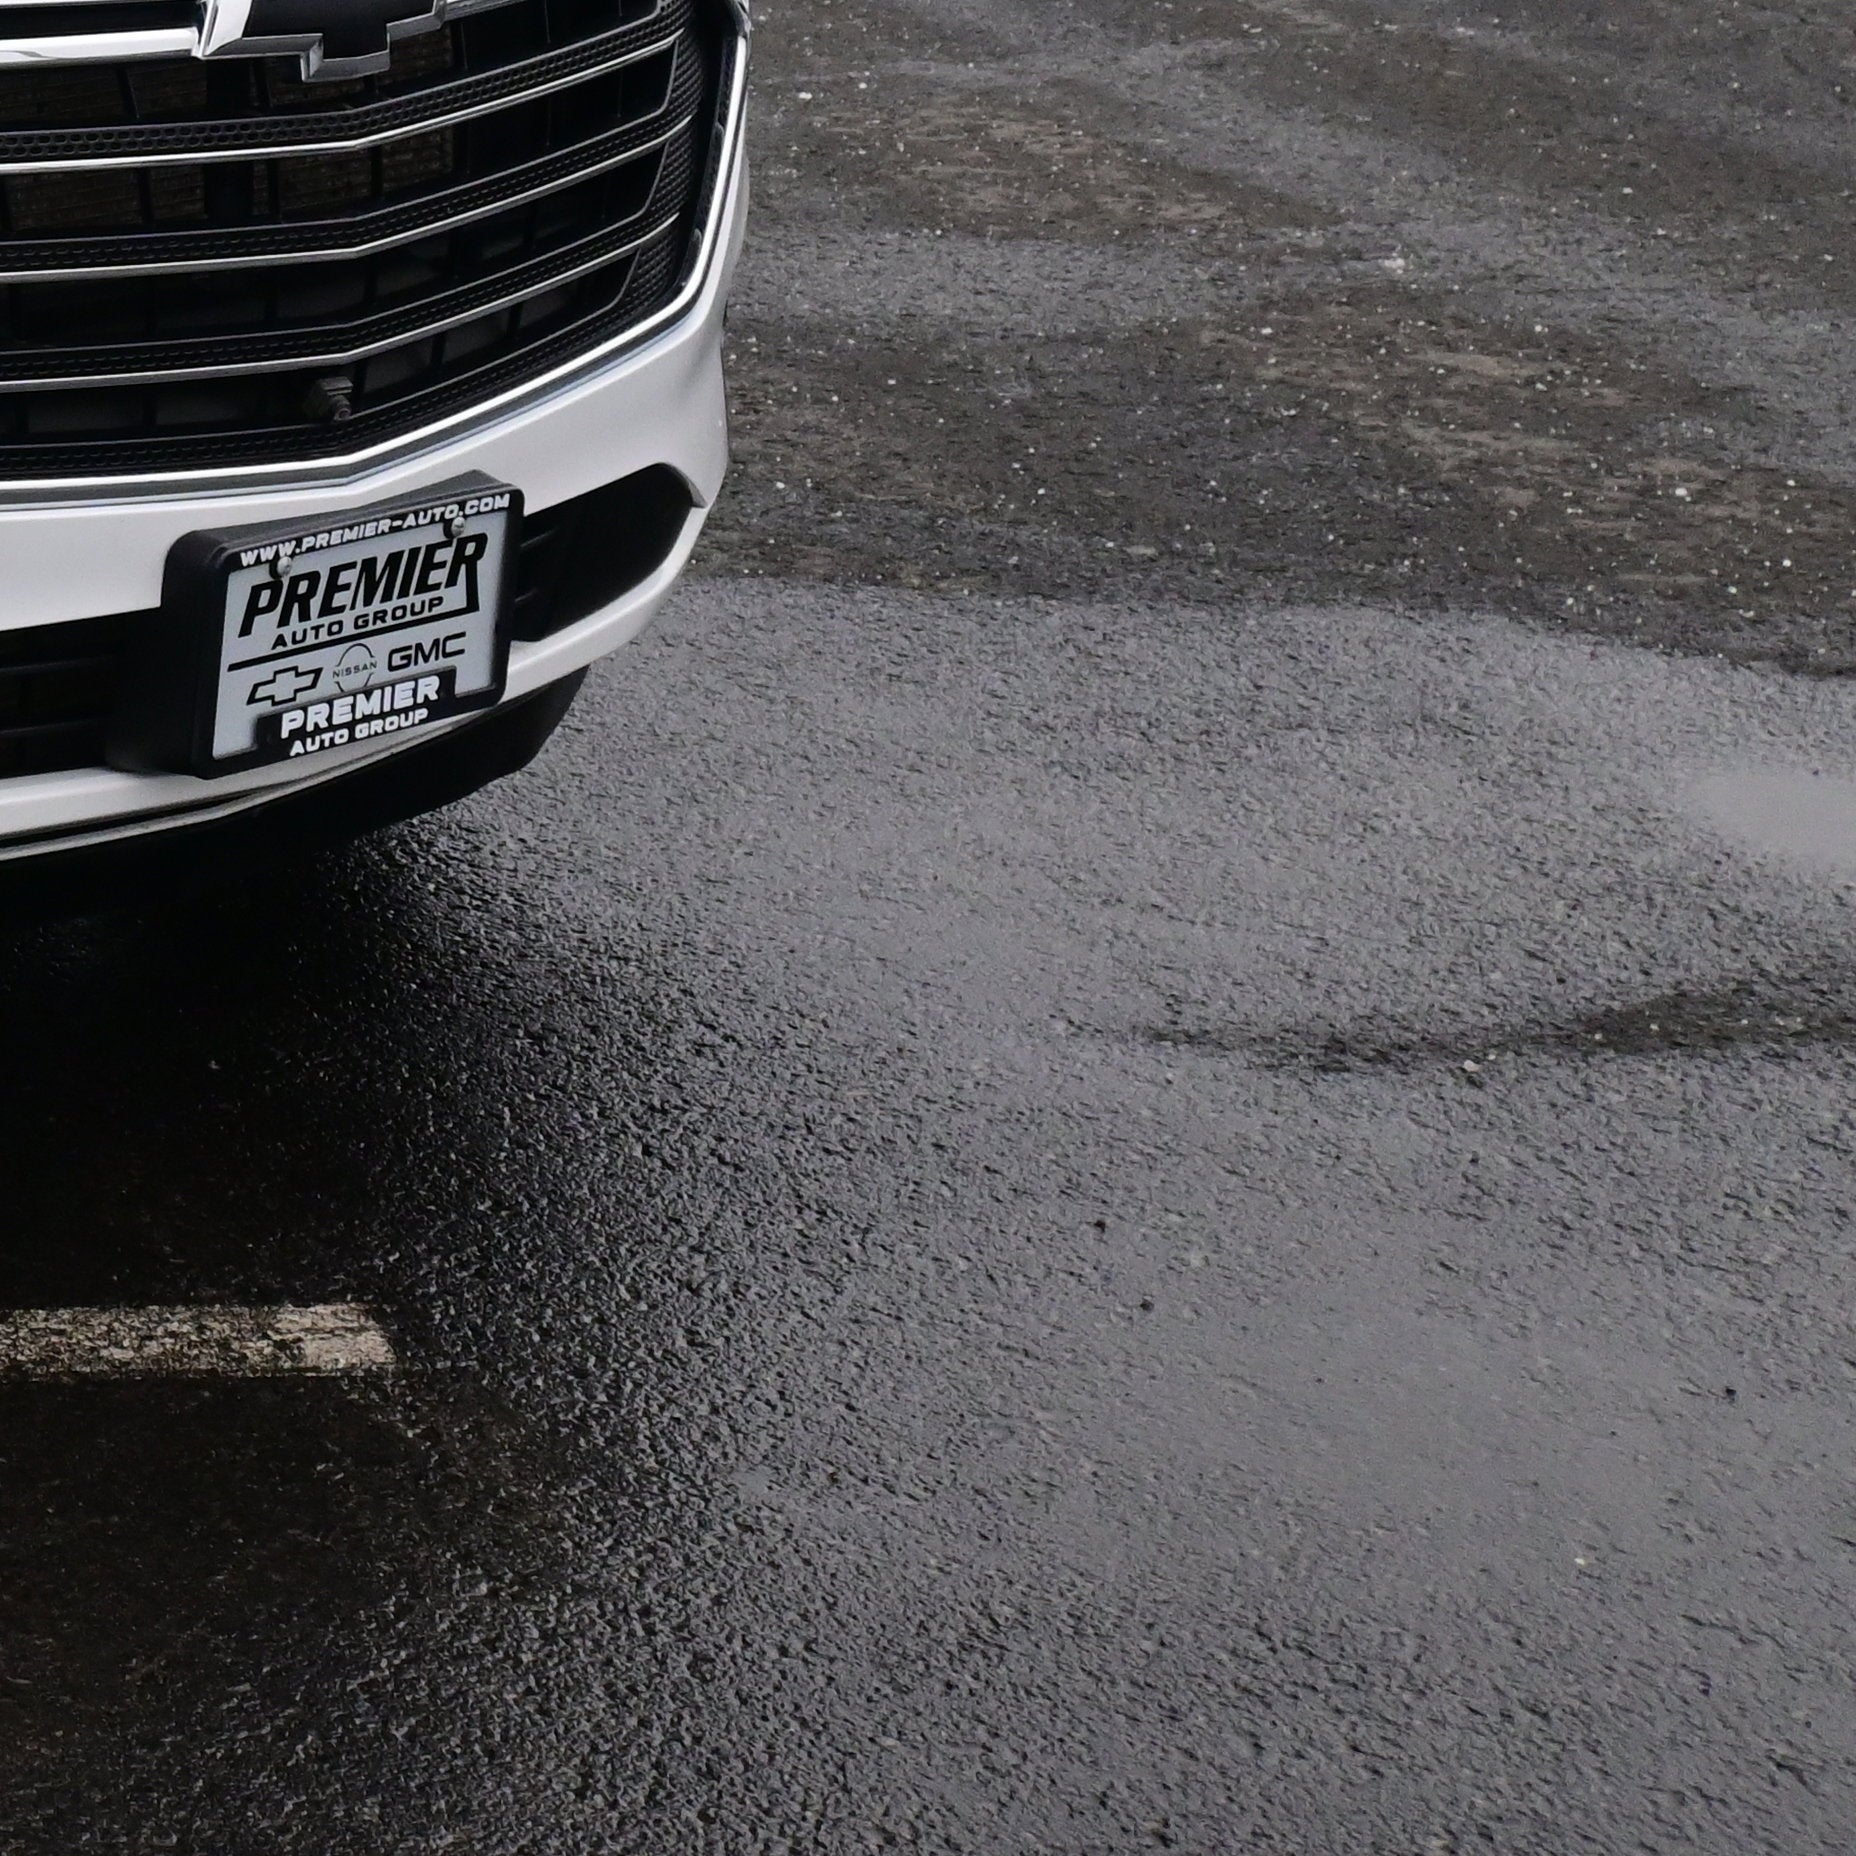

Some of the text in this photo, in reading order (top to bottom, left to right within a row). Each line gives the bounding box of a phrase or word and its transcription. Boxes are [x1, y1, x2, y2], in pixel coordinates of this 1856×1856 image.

[240, 492, 511, 568] WWW.PREMIER-AUTO.COM
[237, 532, 489, 639] PREMIER
[271, 595, 444, 651] AUTO GROUP
[332, 631, 467, 680] NISSAN GMC
[280, 674, 441, 740] PREMIER
[289, 707, 429, 758] AUTO GROUP
